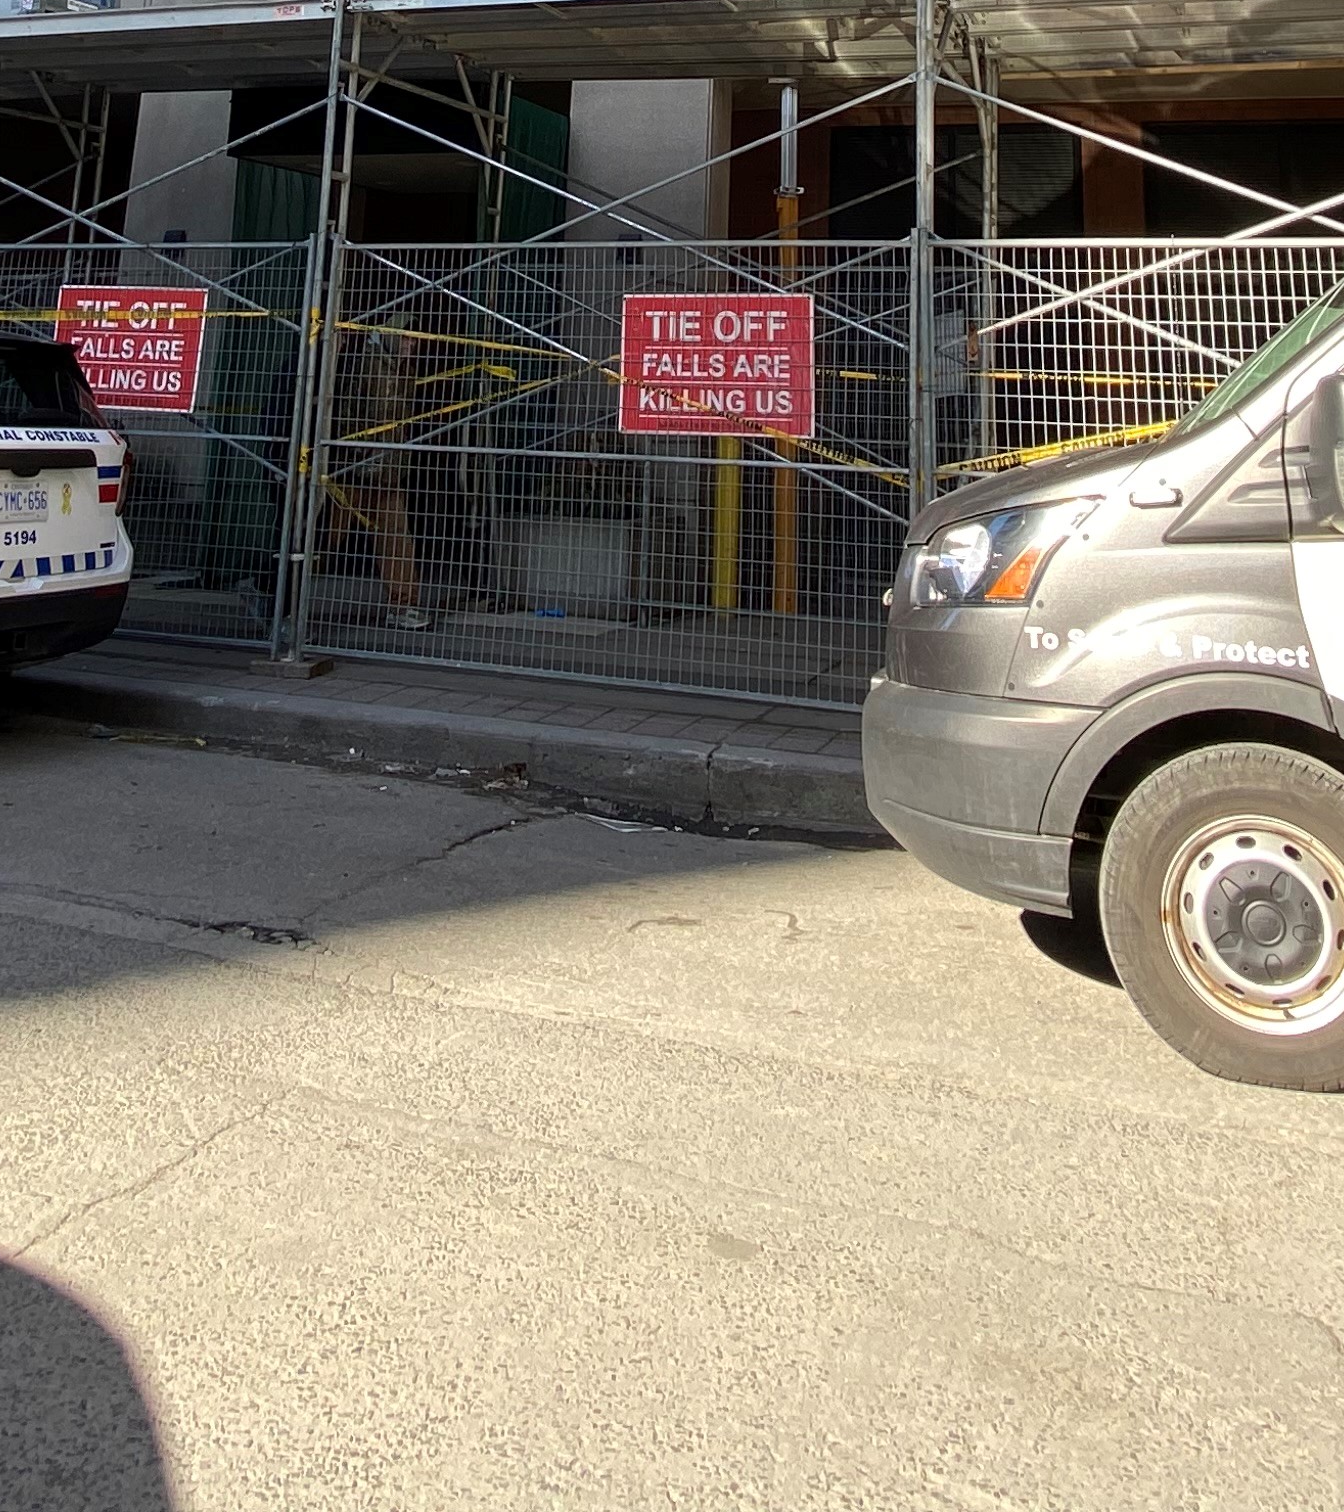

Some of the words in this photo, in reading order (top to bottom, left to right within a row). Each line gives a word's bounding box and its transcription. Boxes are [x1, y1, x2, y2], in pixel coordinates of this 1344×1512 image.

[77, 300, 120, 328] TIE
[128, 301, 187, 330] OFF
[645, 310, 701, 343] TIE
[713, 310, 788, 343] OFF
[138, 339, 185, 361] ARE
[642, 353, 726, 378] FALLS
[733, 354, 791, 379] ARE
[152, 370, 182, 392] US
[638, 388, 747, 413] KILLING
[755, 389, 793, 415] US
[28, 430, 100, 444] CONSTABLE
[3, 530, 37, 546] 5194
[1024, 625, 1059, 651] To
[1191, 635, 1311, 669] Protect
